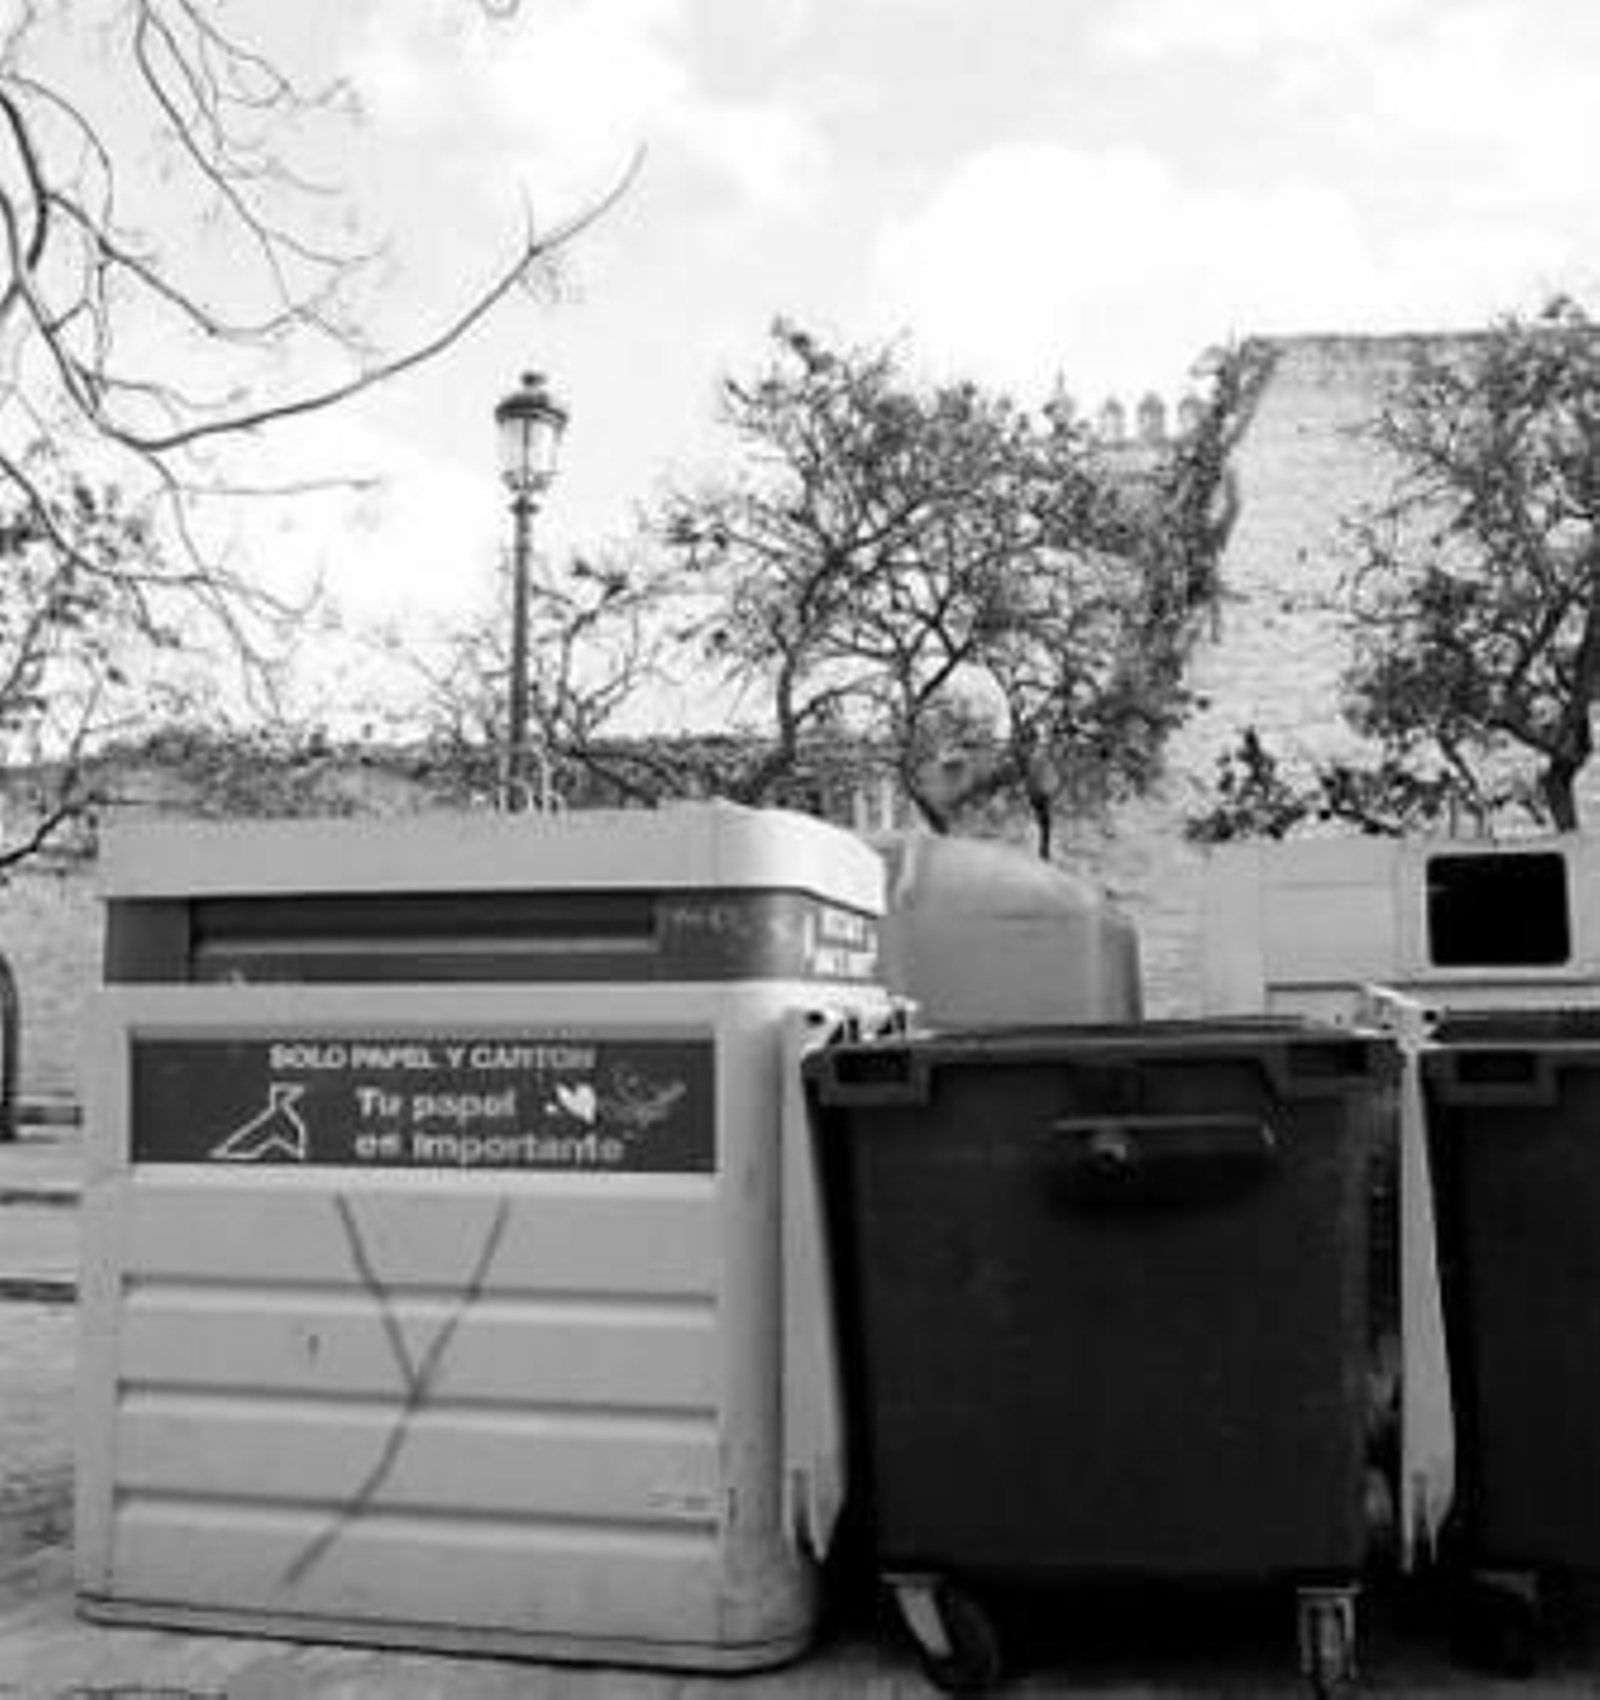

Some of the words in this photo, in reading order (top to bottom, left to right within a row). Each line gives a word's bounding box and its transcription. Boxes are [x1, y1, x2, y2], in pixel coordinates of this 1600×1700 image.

[269, 1043, 347, 1069] SOLO
[350, 1044, 438, 1070] PAPEL
[446, 1046, 467, 1070] Y
[355, 1085, 401, 1117] Tu
[412, 1087, 516, 1125] papel
[355, 1134, 399, 1160] es
[412, 1132, 624, 1165] importante
